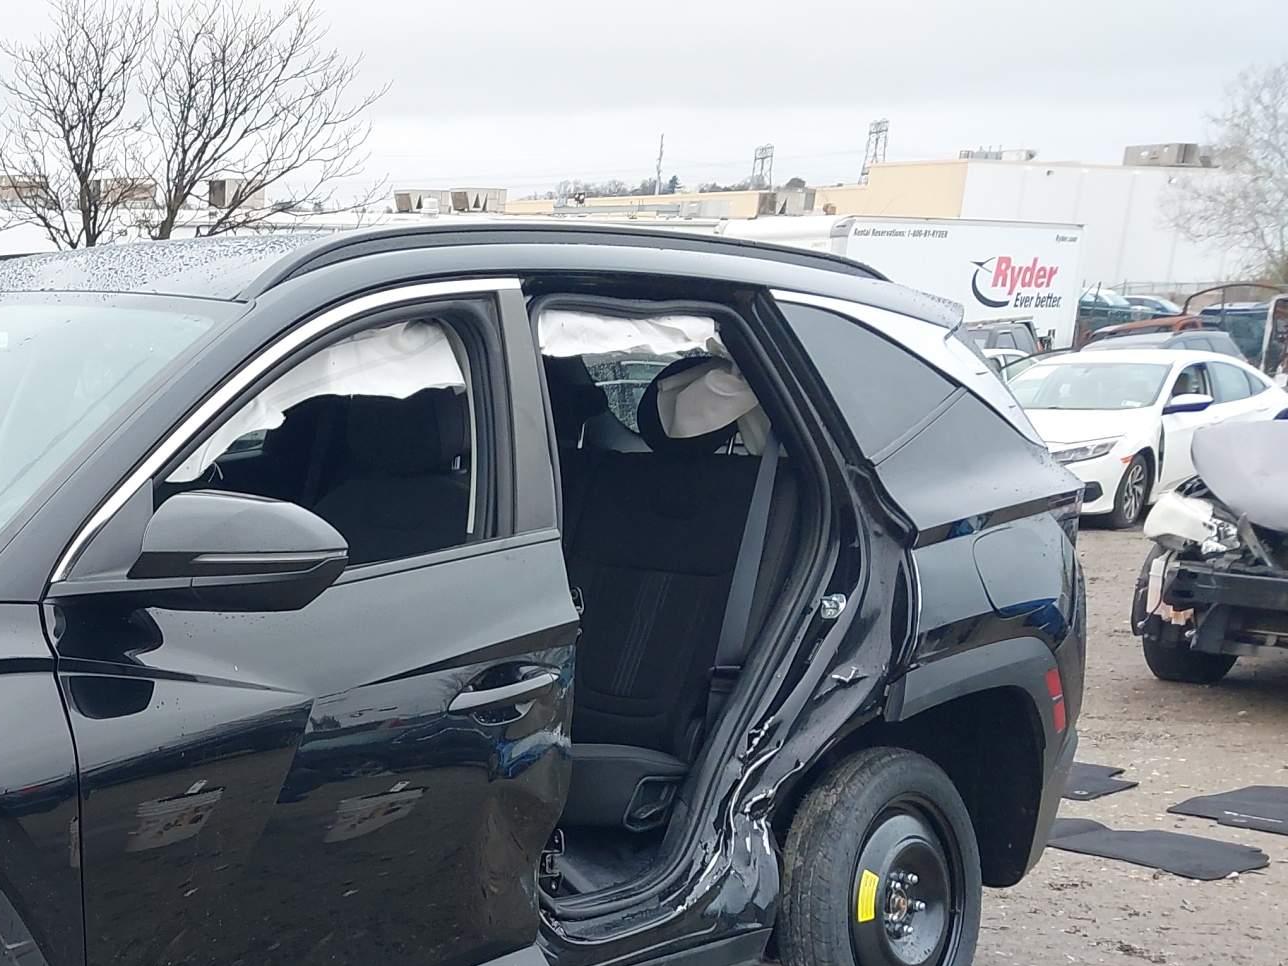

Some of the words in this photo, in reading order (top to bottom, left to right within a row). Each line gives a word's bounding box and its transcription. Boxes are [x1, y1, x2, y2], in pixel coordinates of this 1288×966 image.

[854, 228, 871, 237] Rental
[991, 256, 1059, 296] Ryder
[1013, 292, 1034, 308] Ever
